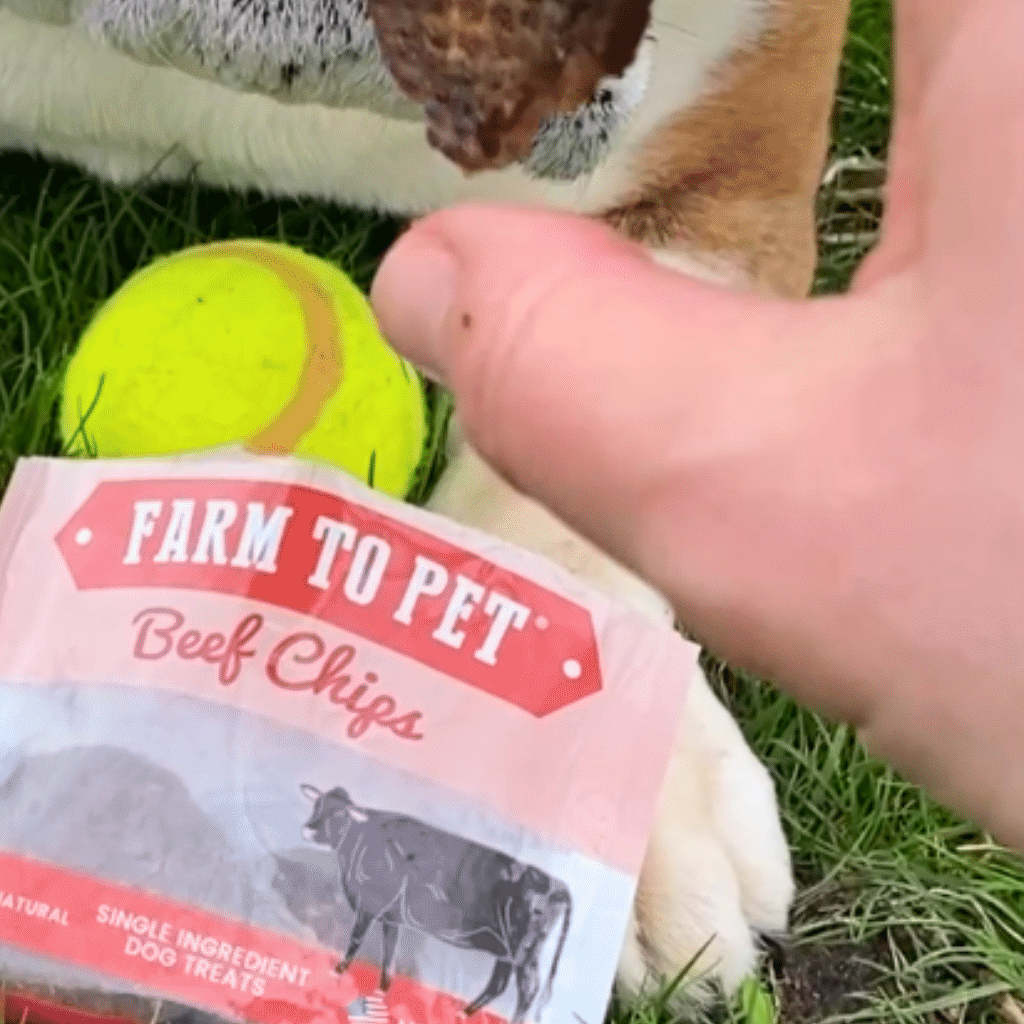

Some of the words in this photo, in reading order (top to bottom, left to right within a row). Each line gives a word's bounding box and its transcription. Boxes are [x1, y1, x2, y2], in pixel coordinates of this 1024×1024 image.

[123, 499, 293, 573] FARM
[308, 516, 392, 606] TO
[394, 555, 531, 665] PET
[133, 607, 264, 685] Beef
[266, 632, 424, 741] Chips
[96, 903, 172, 943] SINGLE
[176, 928, 312, 988] INGREDIENT
[124, 936, 177, 968] DOG
[183, 955, 267, 997] TREATS
